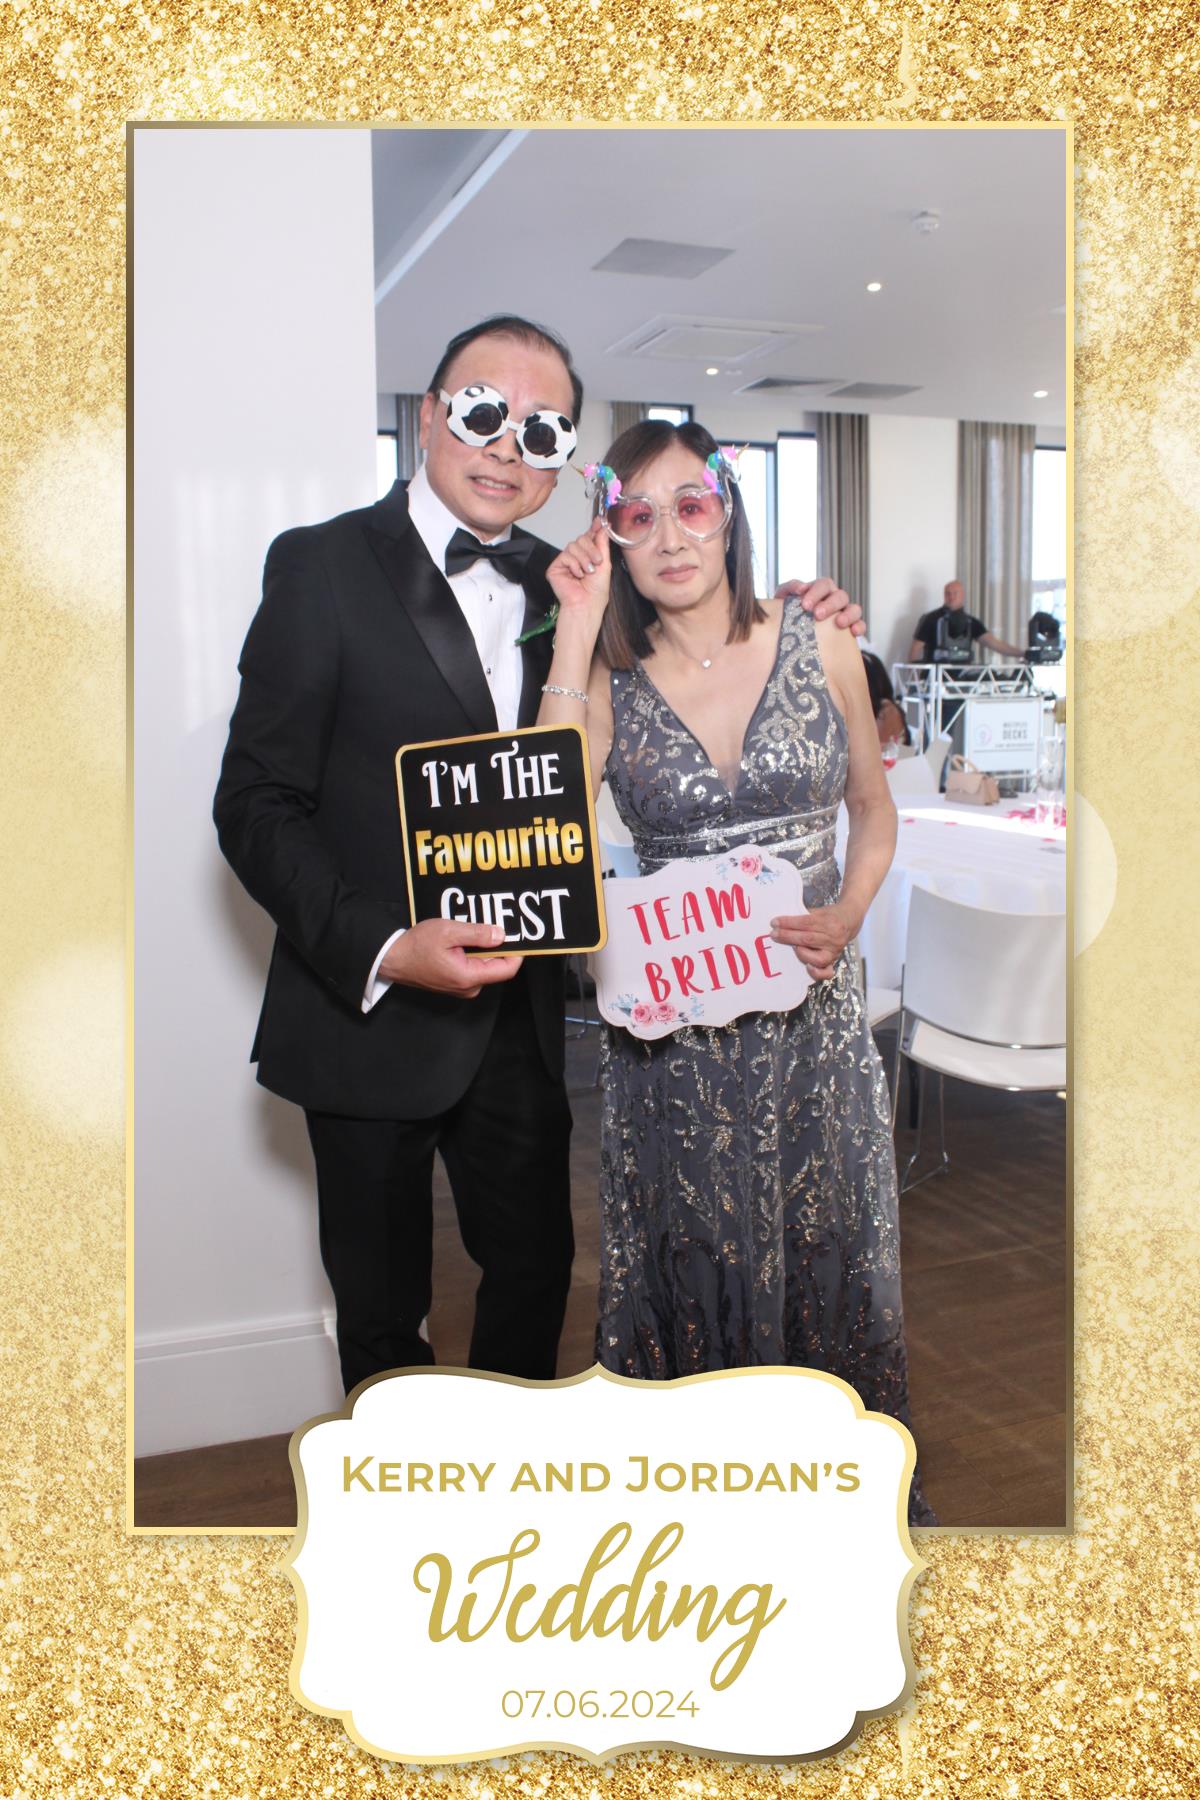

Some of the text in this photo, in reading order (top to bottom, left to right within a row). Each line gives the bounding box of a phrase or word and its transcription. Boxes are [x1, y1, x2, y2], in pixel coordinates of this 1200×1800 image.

[422, 741, 565, 808] I'M THE
[415, 816, 584, 876] Favourite
[440, 887, 570, 942] GUEST
[627, 883, 751, 945] TEAM
[644, 934, 782, 1003] BRIDE
